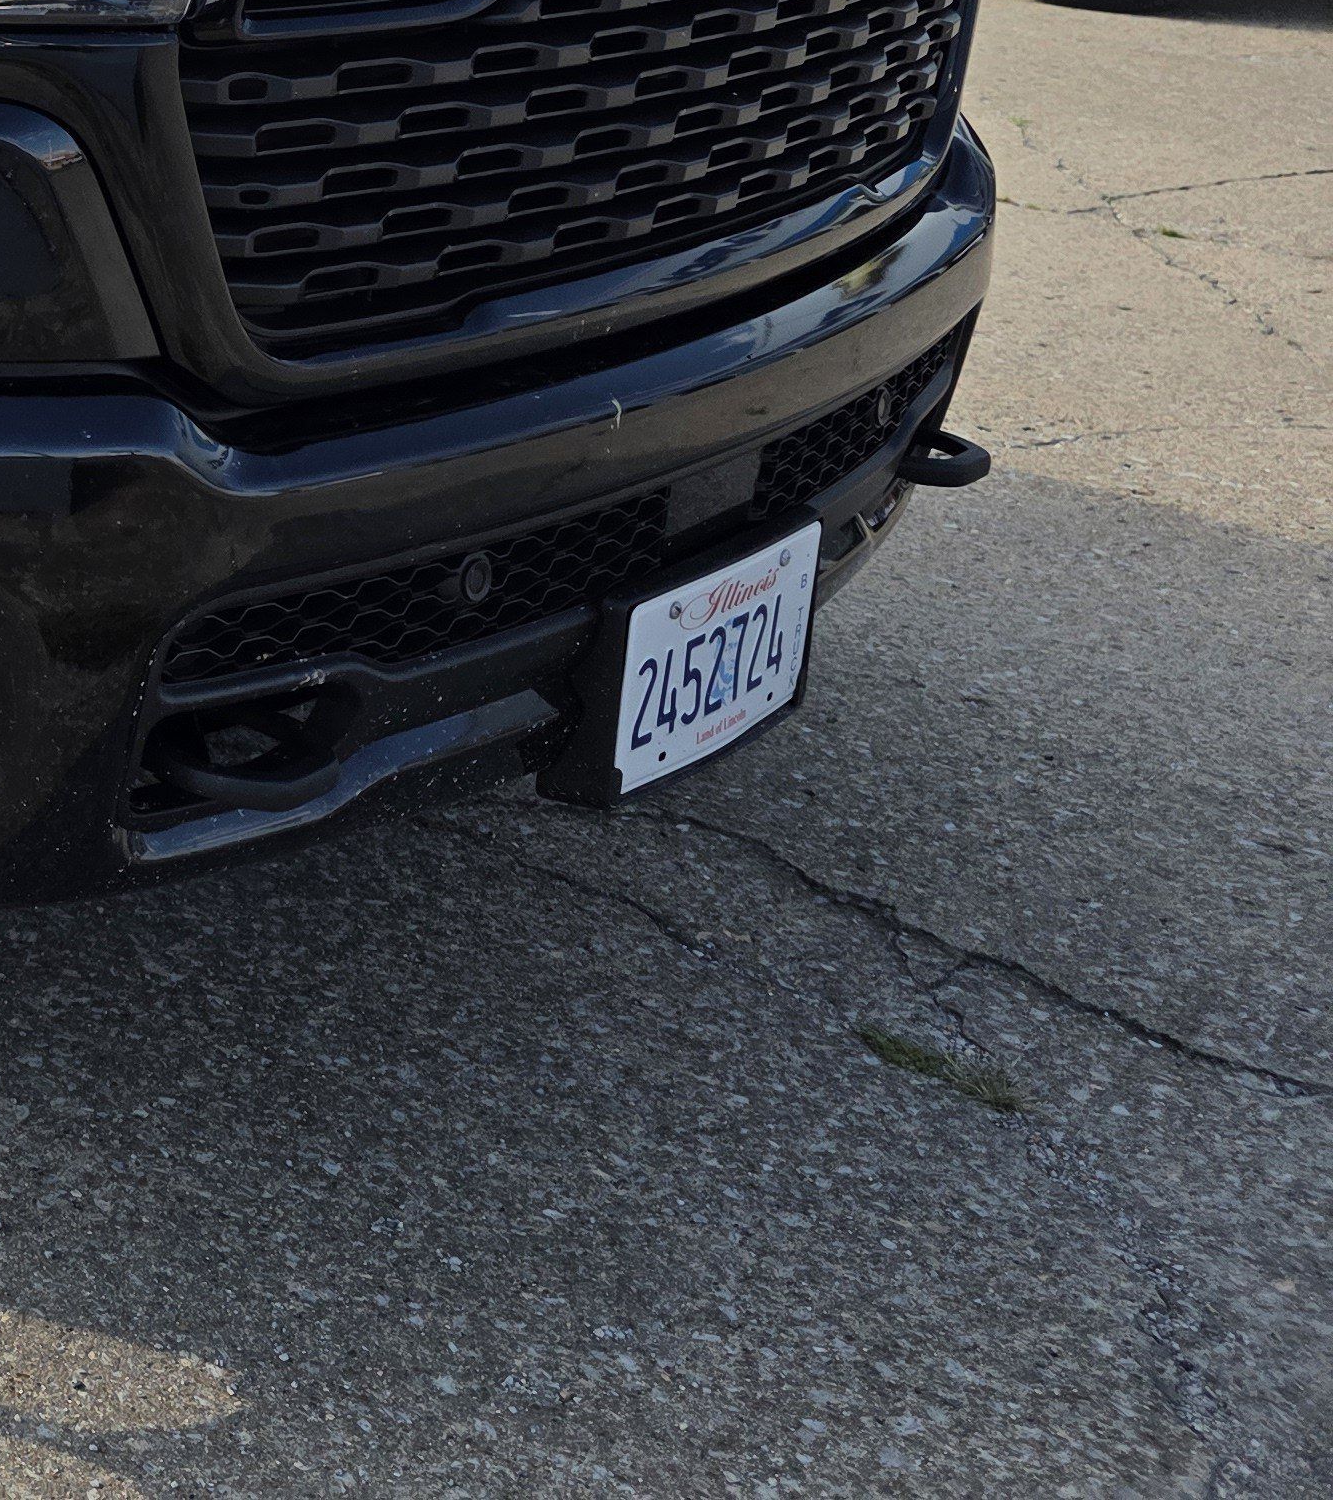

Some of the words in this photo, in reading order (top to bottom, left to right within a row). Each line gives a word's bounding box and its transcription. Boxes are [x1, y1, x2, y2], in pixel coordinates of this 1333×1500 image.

[679, 566, 781, 631] Illinois
[800, 573, 808, 590] B
[631, 594, 783, 750] 2452724
[788, 607, 803, 689] TRUCK
[696, 724, 714, 744] Land
